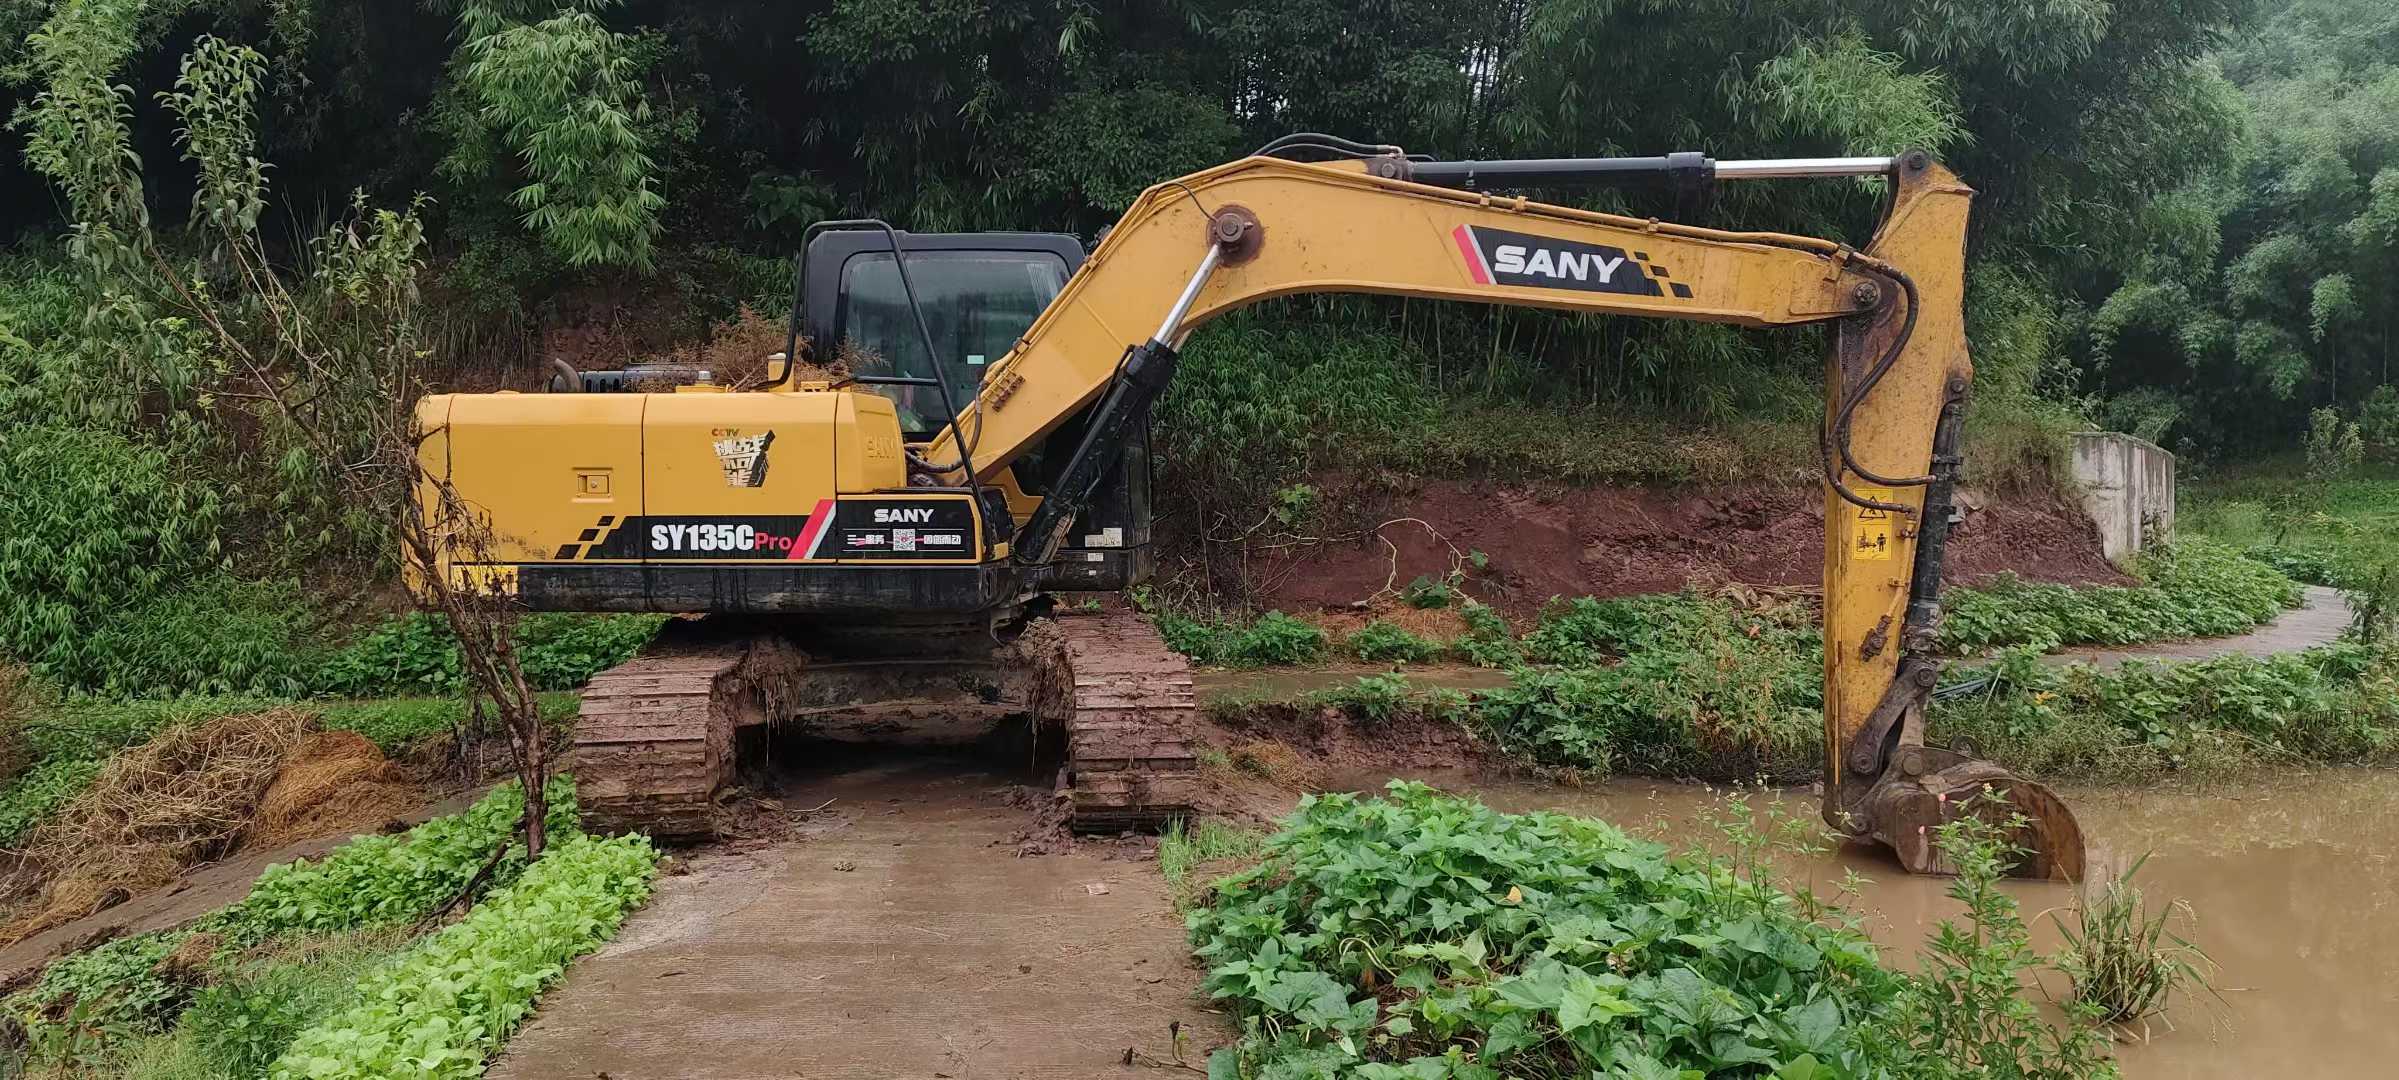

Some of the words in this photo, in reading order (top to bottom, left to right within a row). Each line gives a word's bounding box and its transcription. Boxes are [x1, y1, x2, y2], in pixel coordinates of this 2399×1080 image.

[1494, 244, 1625, 284] SANY
[711, 428, 740, 437] CCTV
[874, 508, 935, 523] SANY
[651, 524, 754, 551] SY135C
[754, 532, 793, 551] Pro
